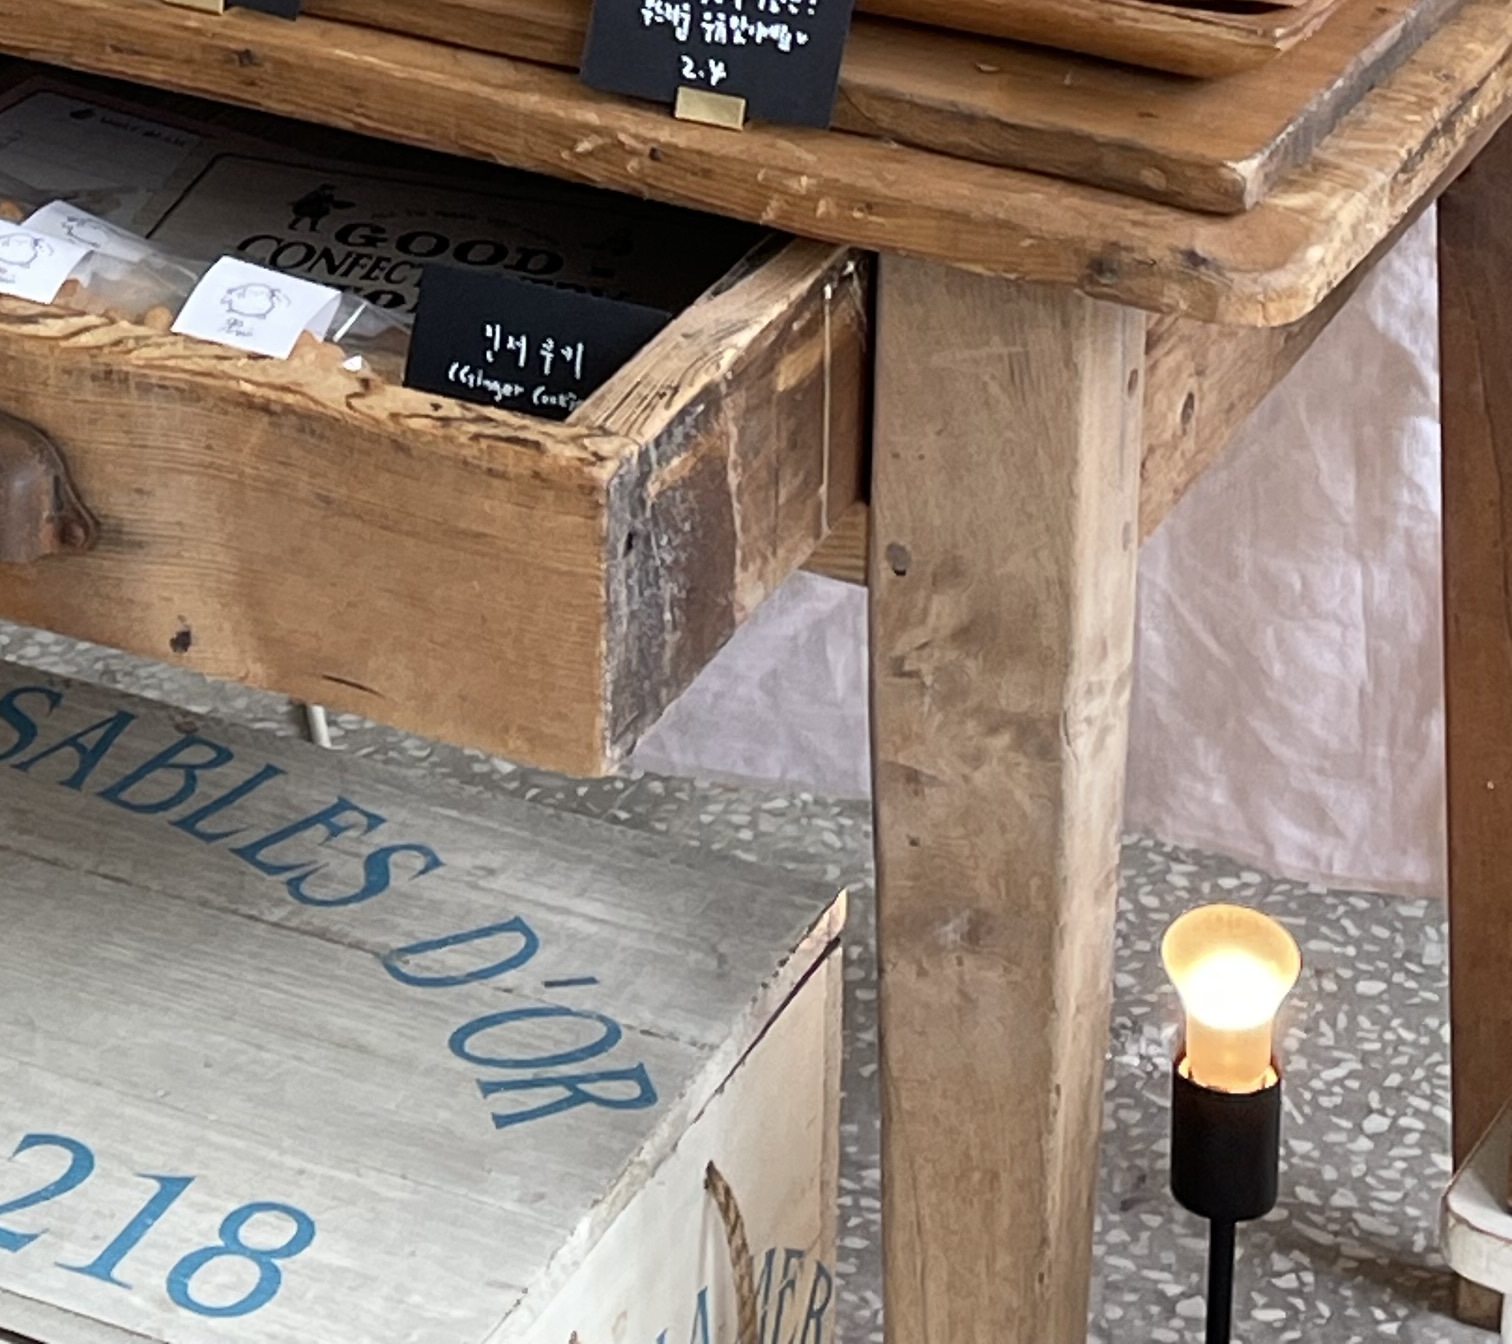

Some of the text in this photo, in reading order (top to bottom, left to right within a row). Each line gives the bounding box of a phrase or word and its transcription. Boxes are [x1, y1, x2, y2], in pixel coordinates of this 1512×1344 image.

[680, 55, 727, 86] 2.4
[333, 222, 565, 276] GOOD
[540, 337, 584, 381] 쿠키
[379, 914, 658, 1131] D'OR
